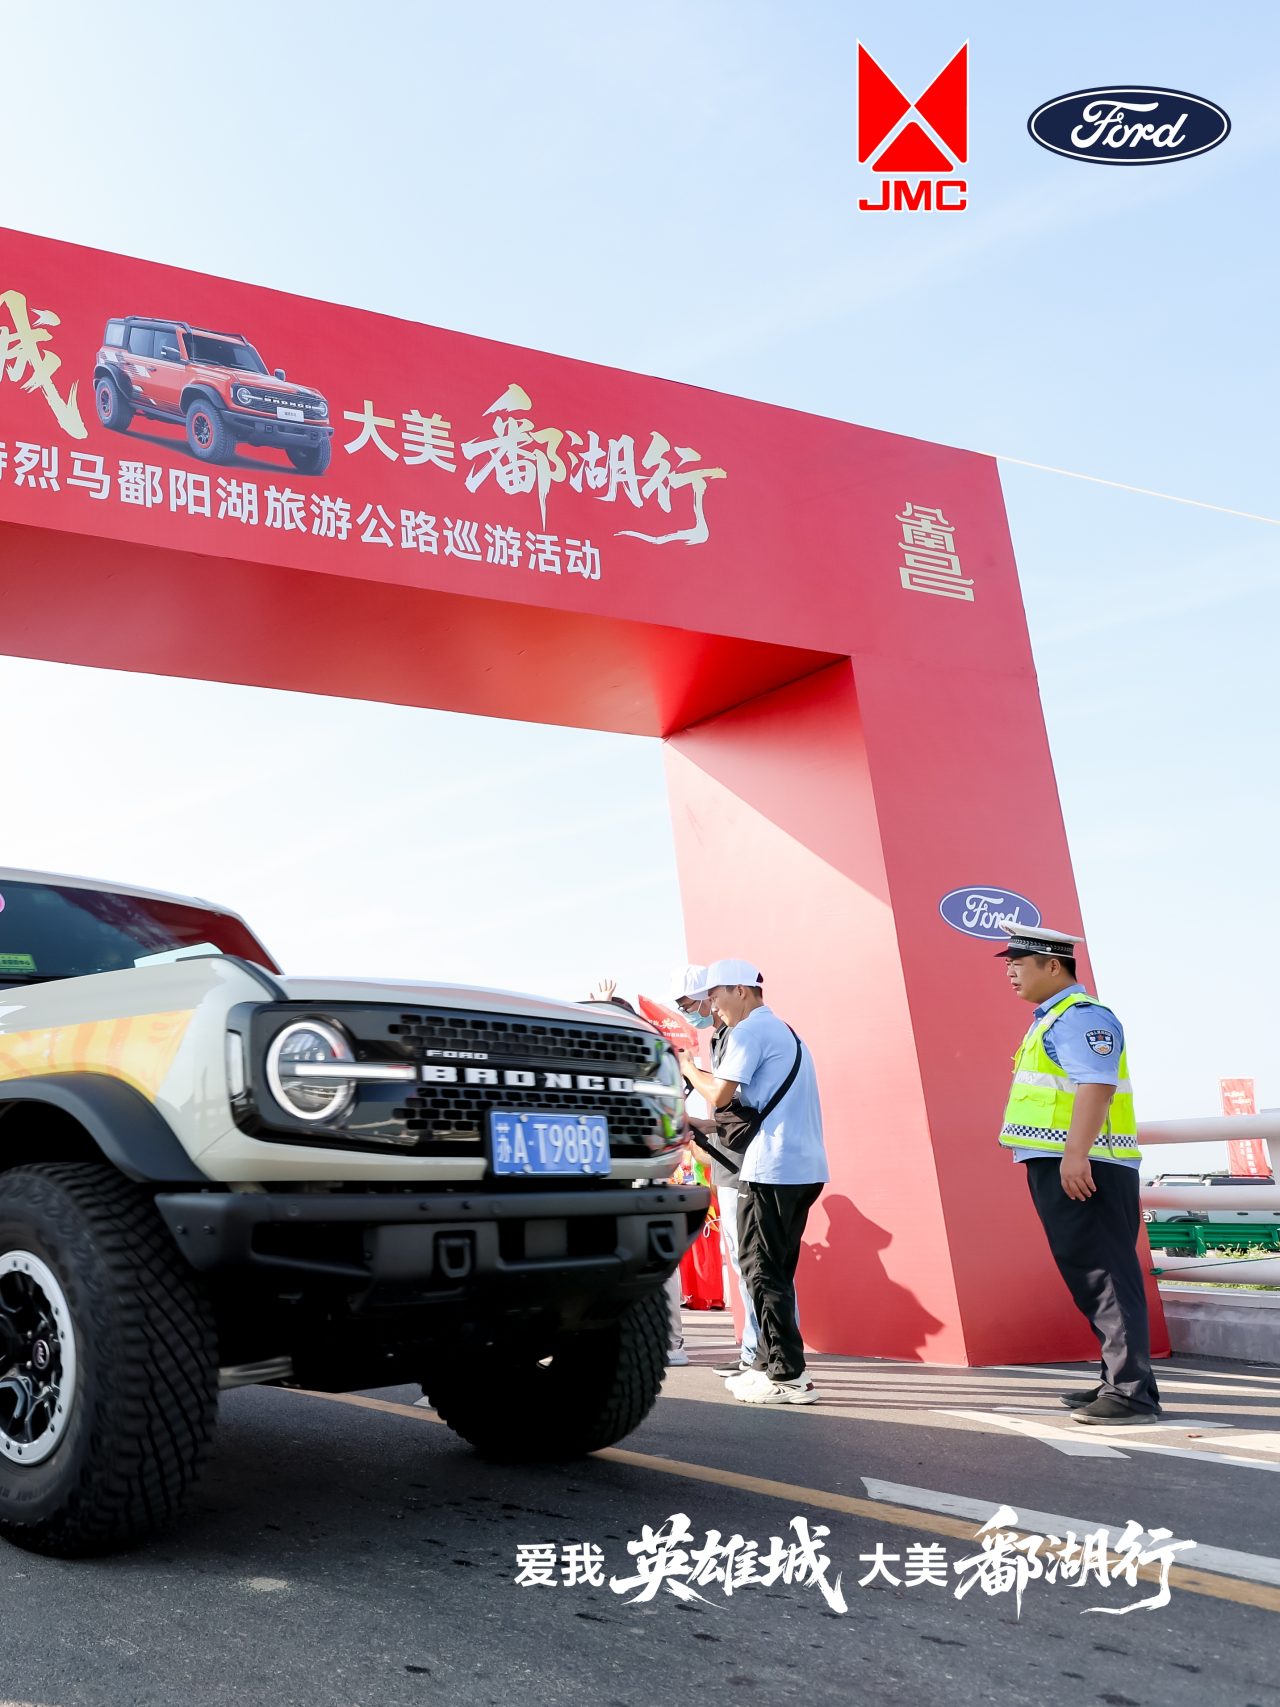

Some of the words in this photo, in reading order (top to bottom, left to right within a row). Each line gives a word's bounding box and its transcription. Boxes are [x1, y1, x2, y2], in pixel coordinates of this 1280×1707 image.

[962, 894, 1021, 929] Ford
[426, 1049, 488, 1060] FORD
[421, 1065, 634, 1093] BRONCO
